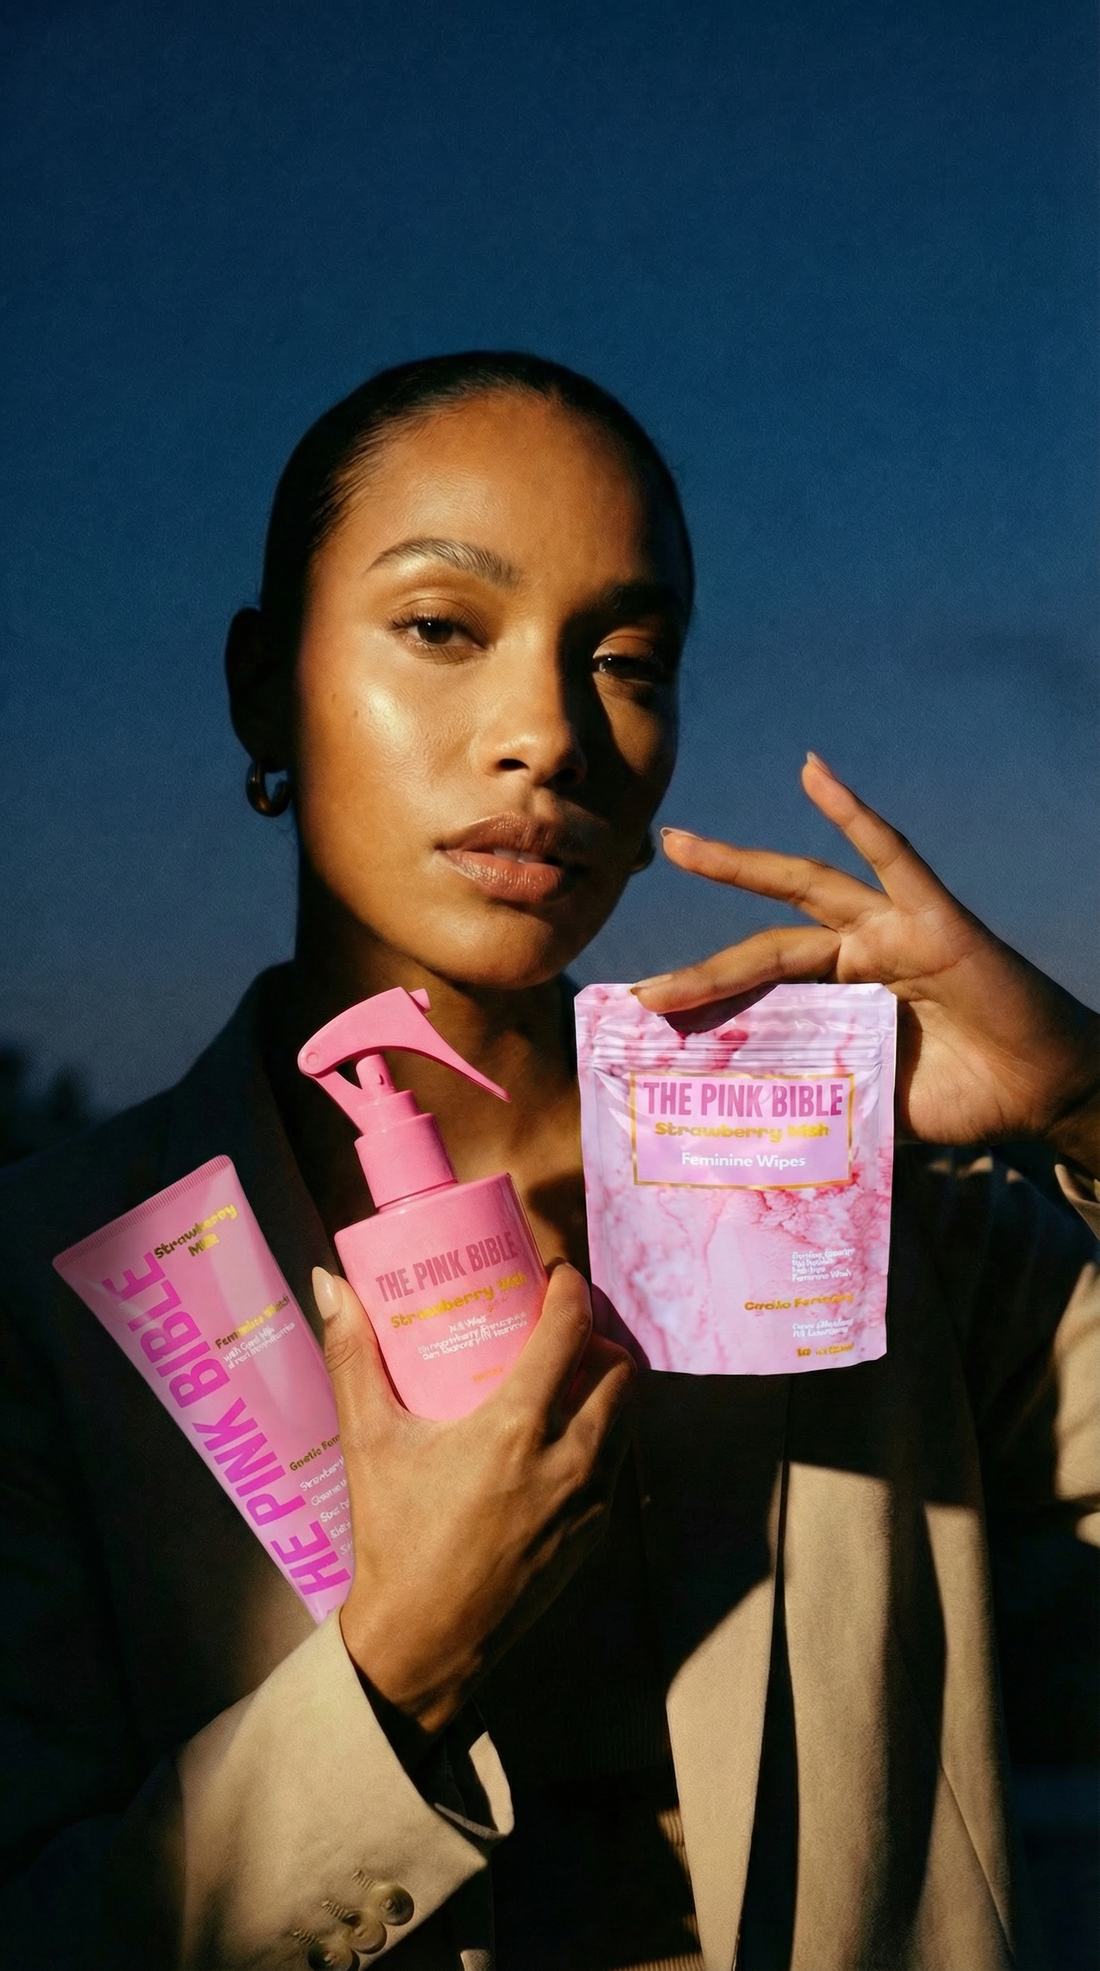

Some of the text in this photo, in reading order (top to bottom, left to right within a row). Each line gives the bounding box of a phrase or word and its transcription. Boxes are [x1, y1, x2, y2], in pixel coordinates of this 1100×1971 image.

[643, 1082, 843, 1117] THE PINK BIBLE
[655, 1121, 782, 1142] Strawberry
[681, 1152, 806, 1170] Feminine Wipes
[375, 1231, 518, 1302] THE PINK BIBLE
[101, 1251, 230, 1408] BIBLE
[390, 1285, 495, 1328] Strawberry
[192, 1397, 306, 1526] PINK
[270, 1520, 351, 1615] HE
